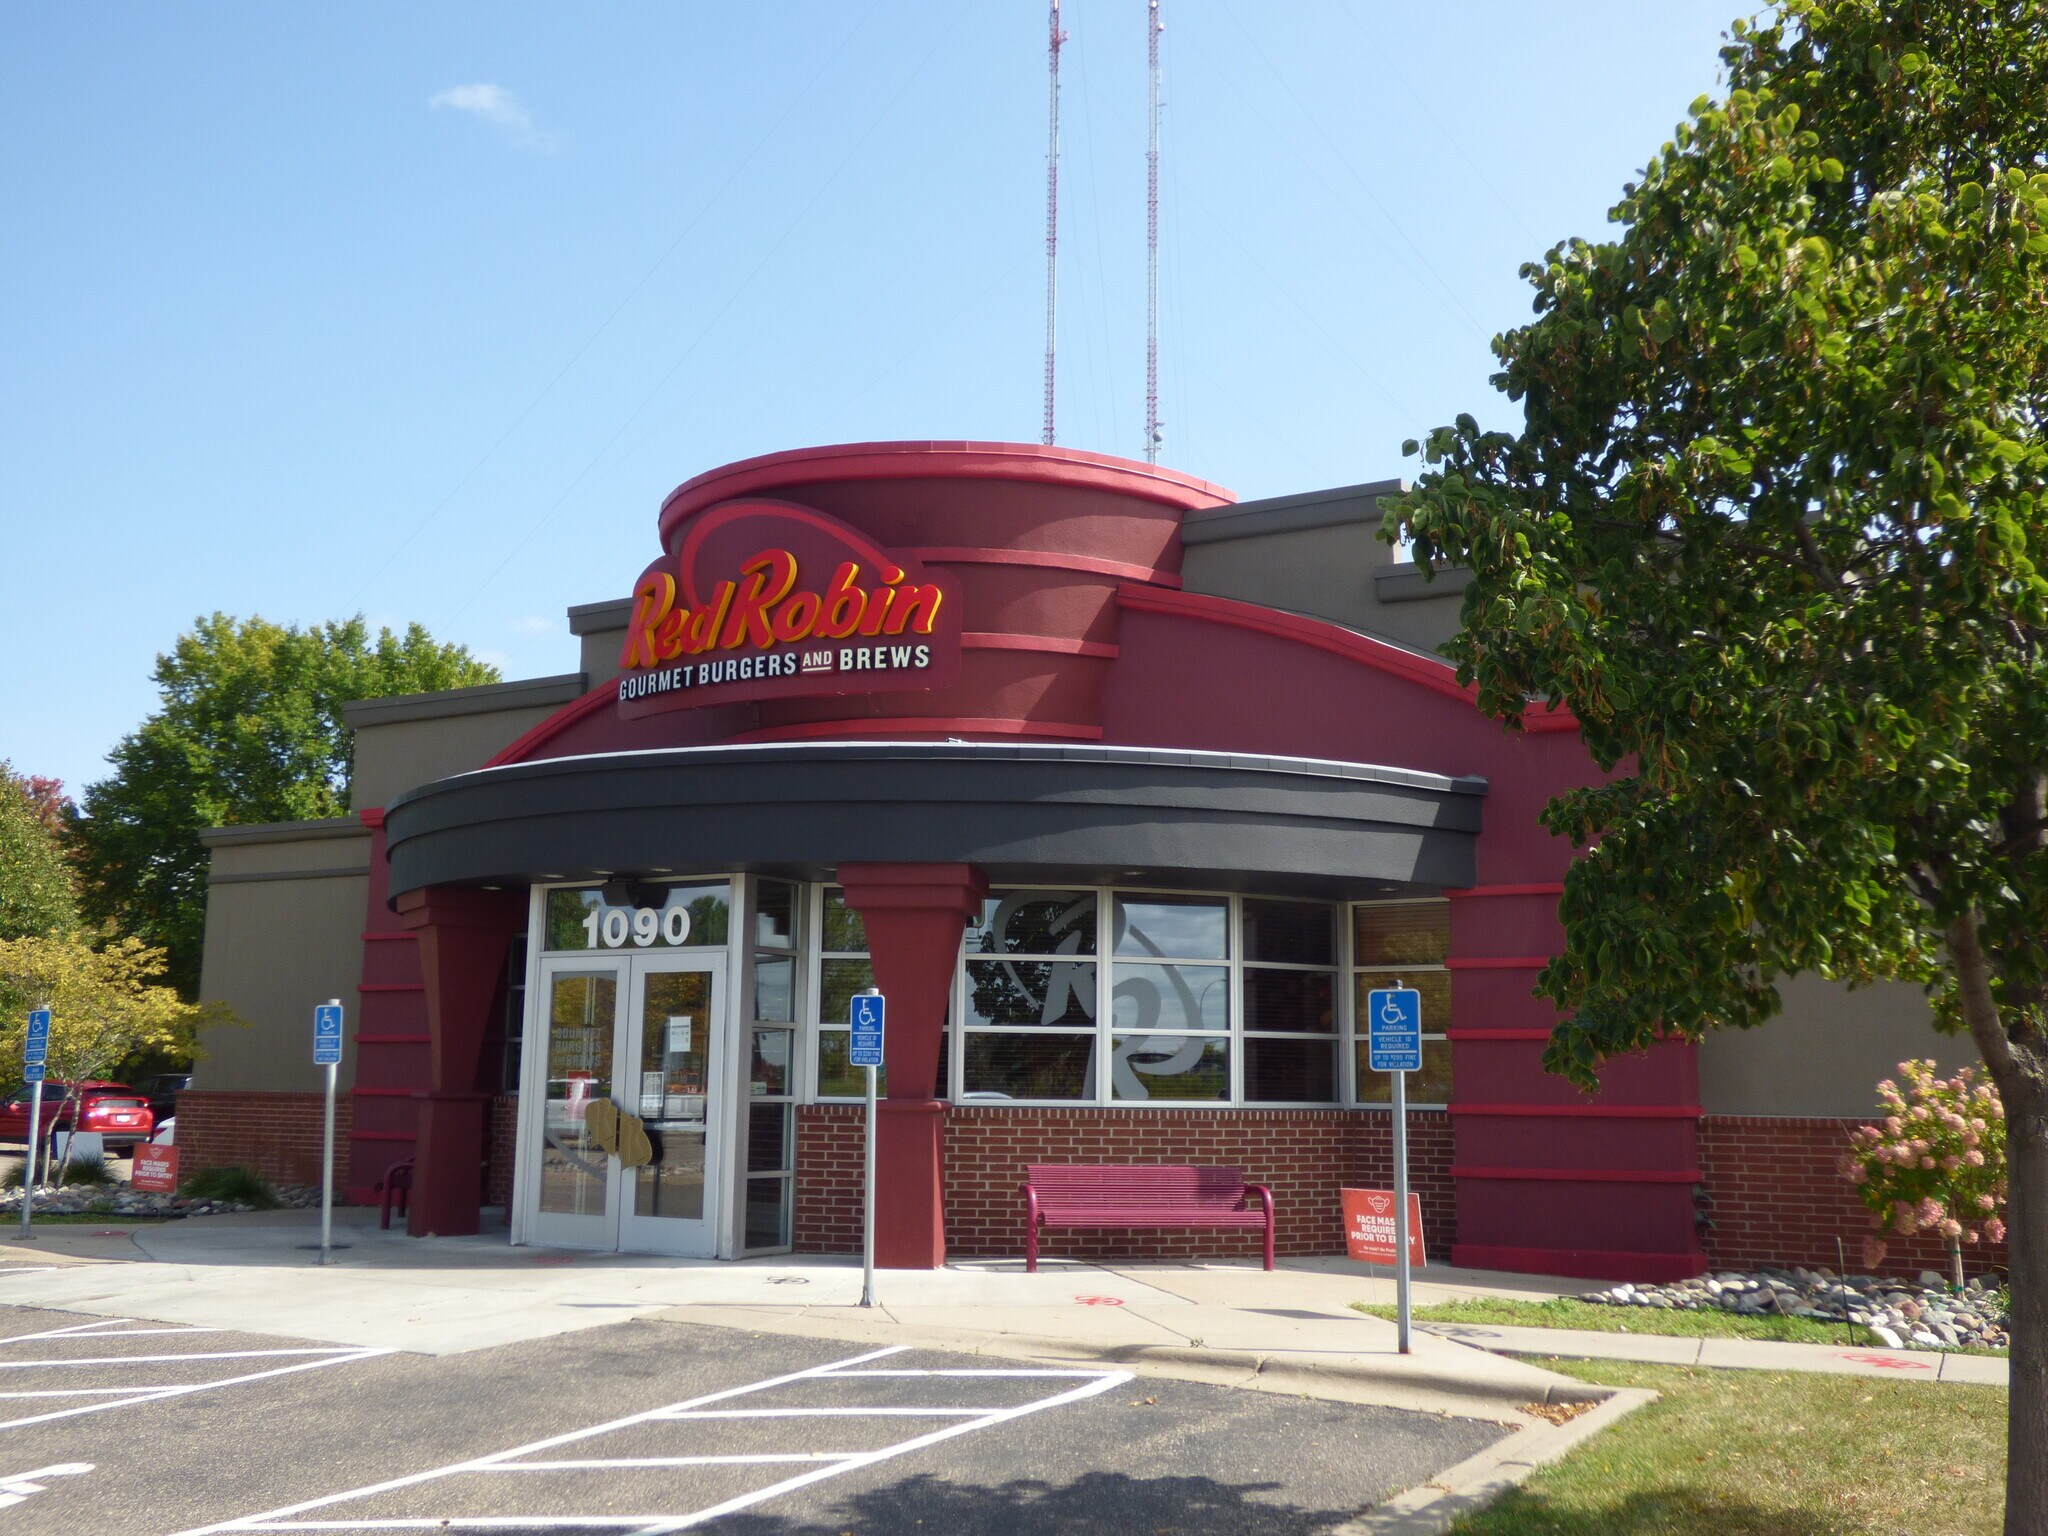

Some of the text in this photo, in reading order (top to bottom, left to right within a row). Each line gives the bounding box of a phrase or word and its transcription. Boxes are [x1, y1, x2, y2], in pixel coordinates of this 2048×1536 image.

[619, 645, 930, 701] GOURMET BURGERS AND BREWS
[582, 906, 691, 949] 1090
[1356, 1215, 1396, 1226] FACE MAS
[1361, 1224, 1396, 1235] REQUIRE
[1351, 1231, 1375, 1242] PRIOR
[1375, 1234, 1387, 1243] TO
